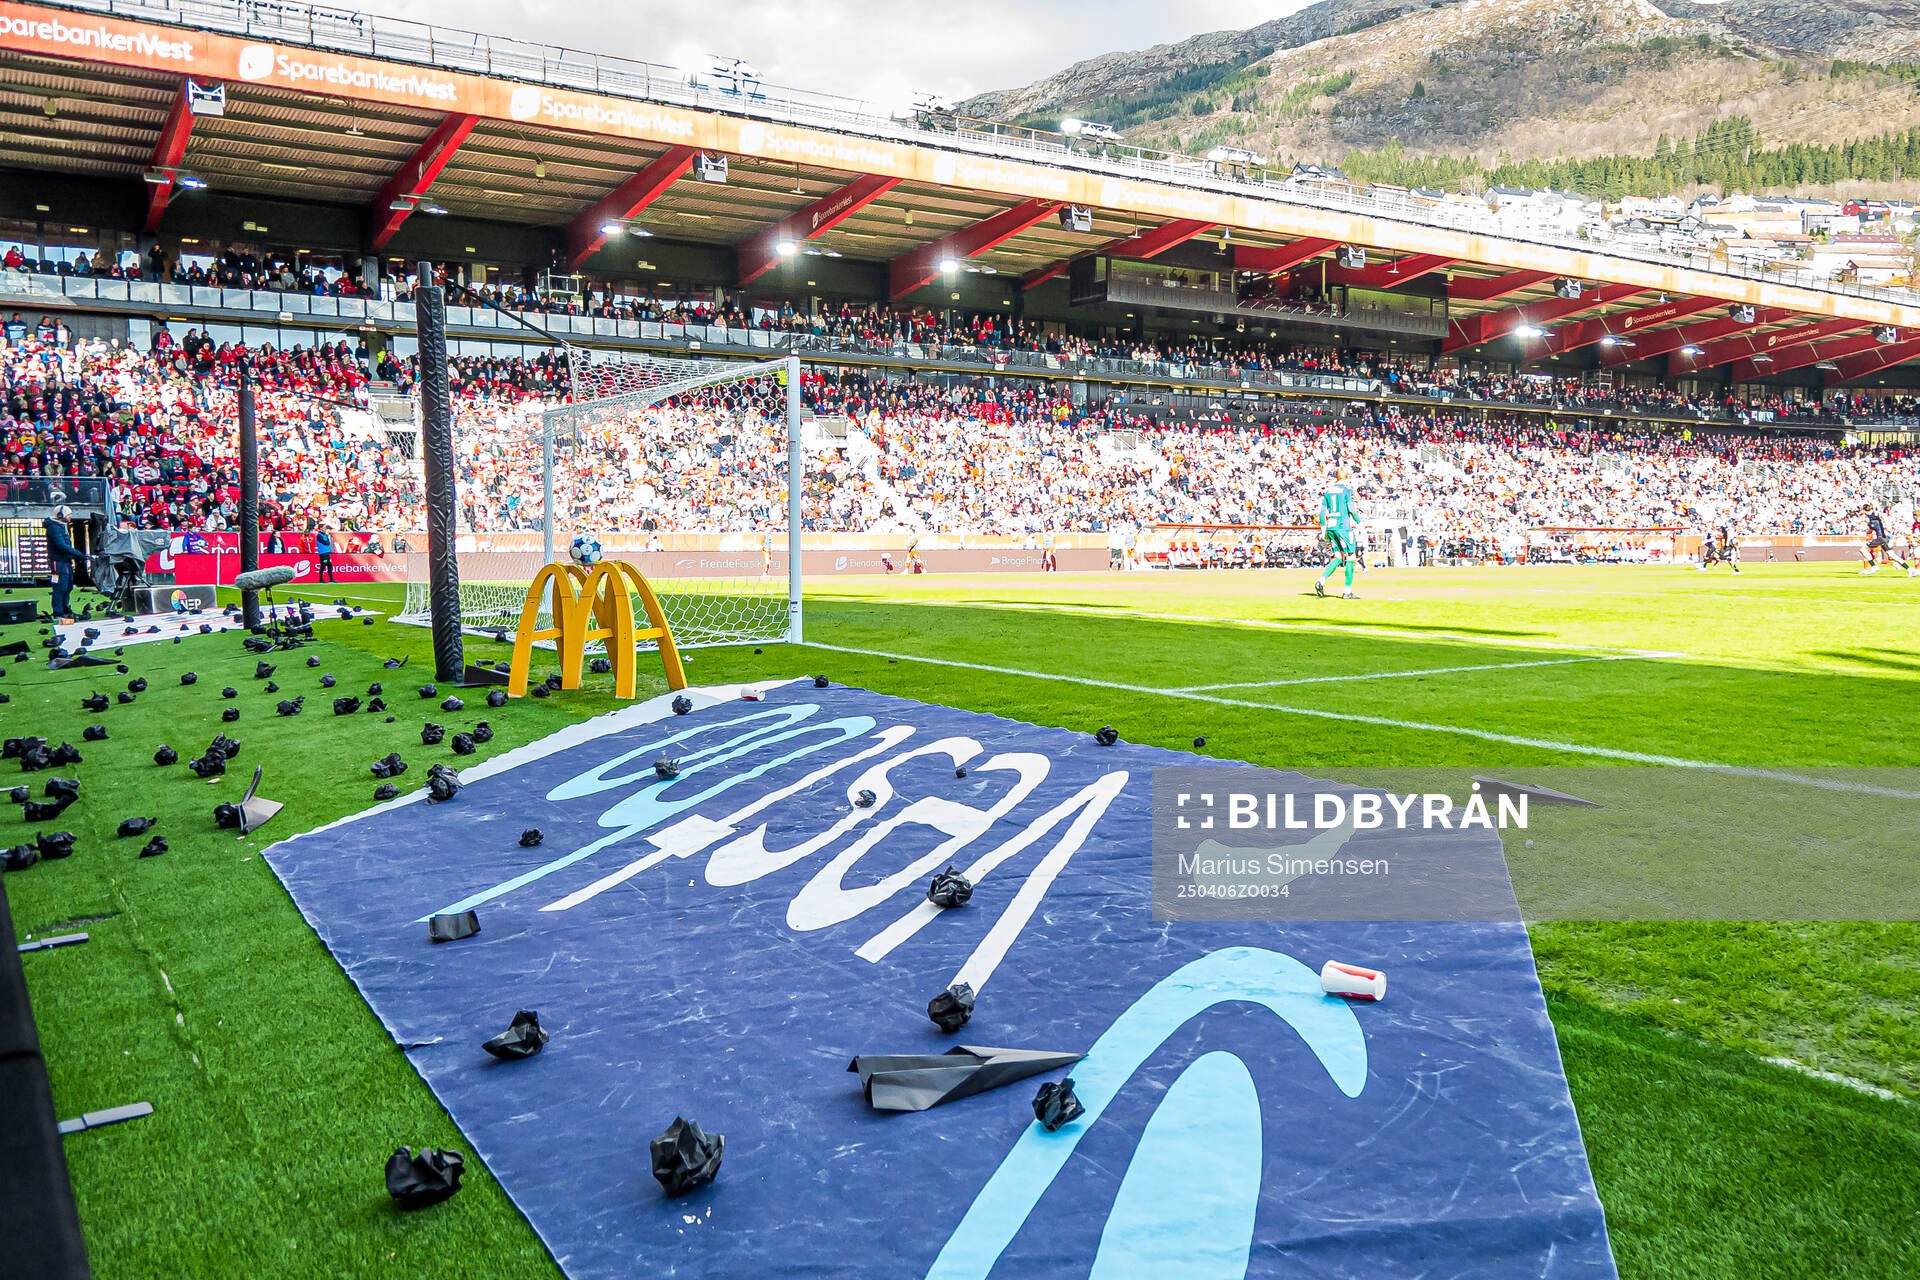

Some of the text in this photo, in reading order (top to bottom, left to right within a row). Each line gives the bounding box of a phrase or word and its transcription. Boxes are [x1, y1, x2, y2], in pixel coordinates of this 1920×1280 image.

[0, 16, 194, 62] parebankenVest
[275, 54, 458, 101] SparebankenVest
[314, 562, 408, 573] SrebankenVest
